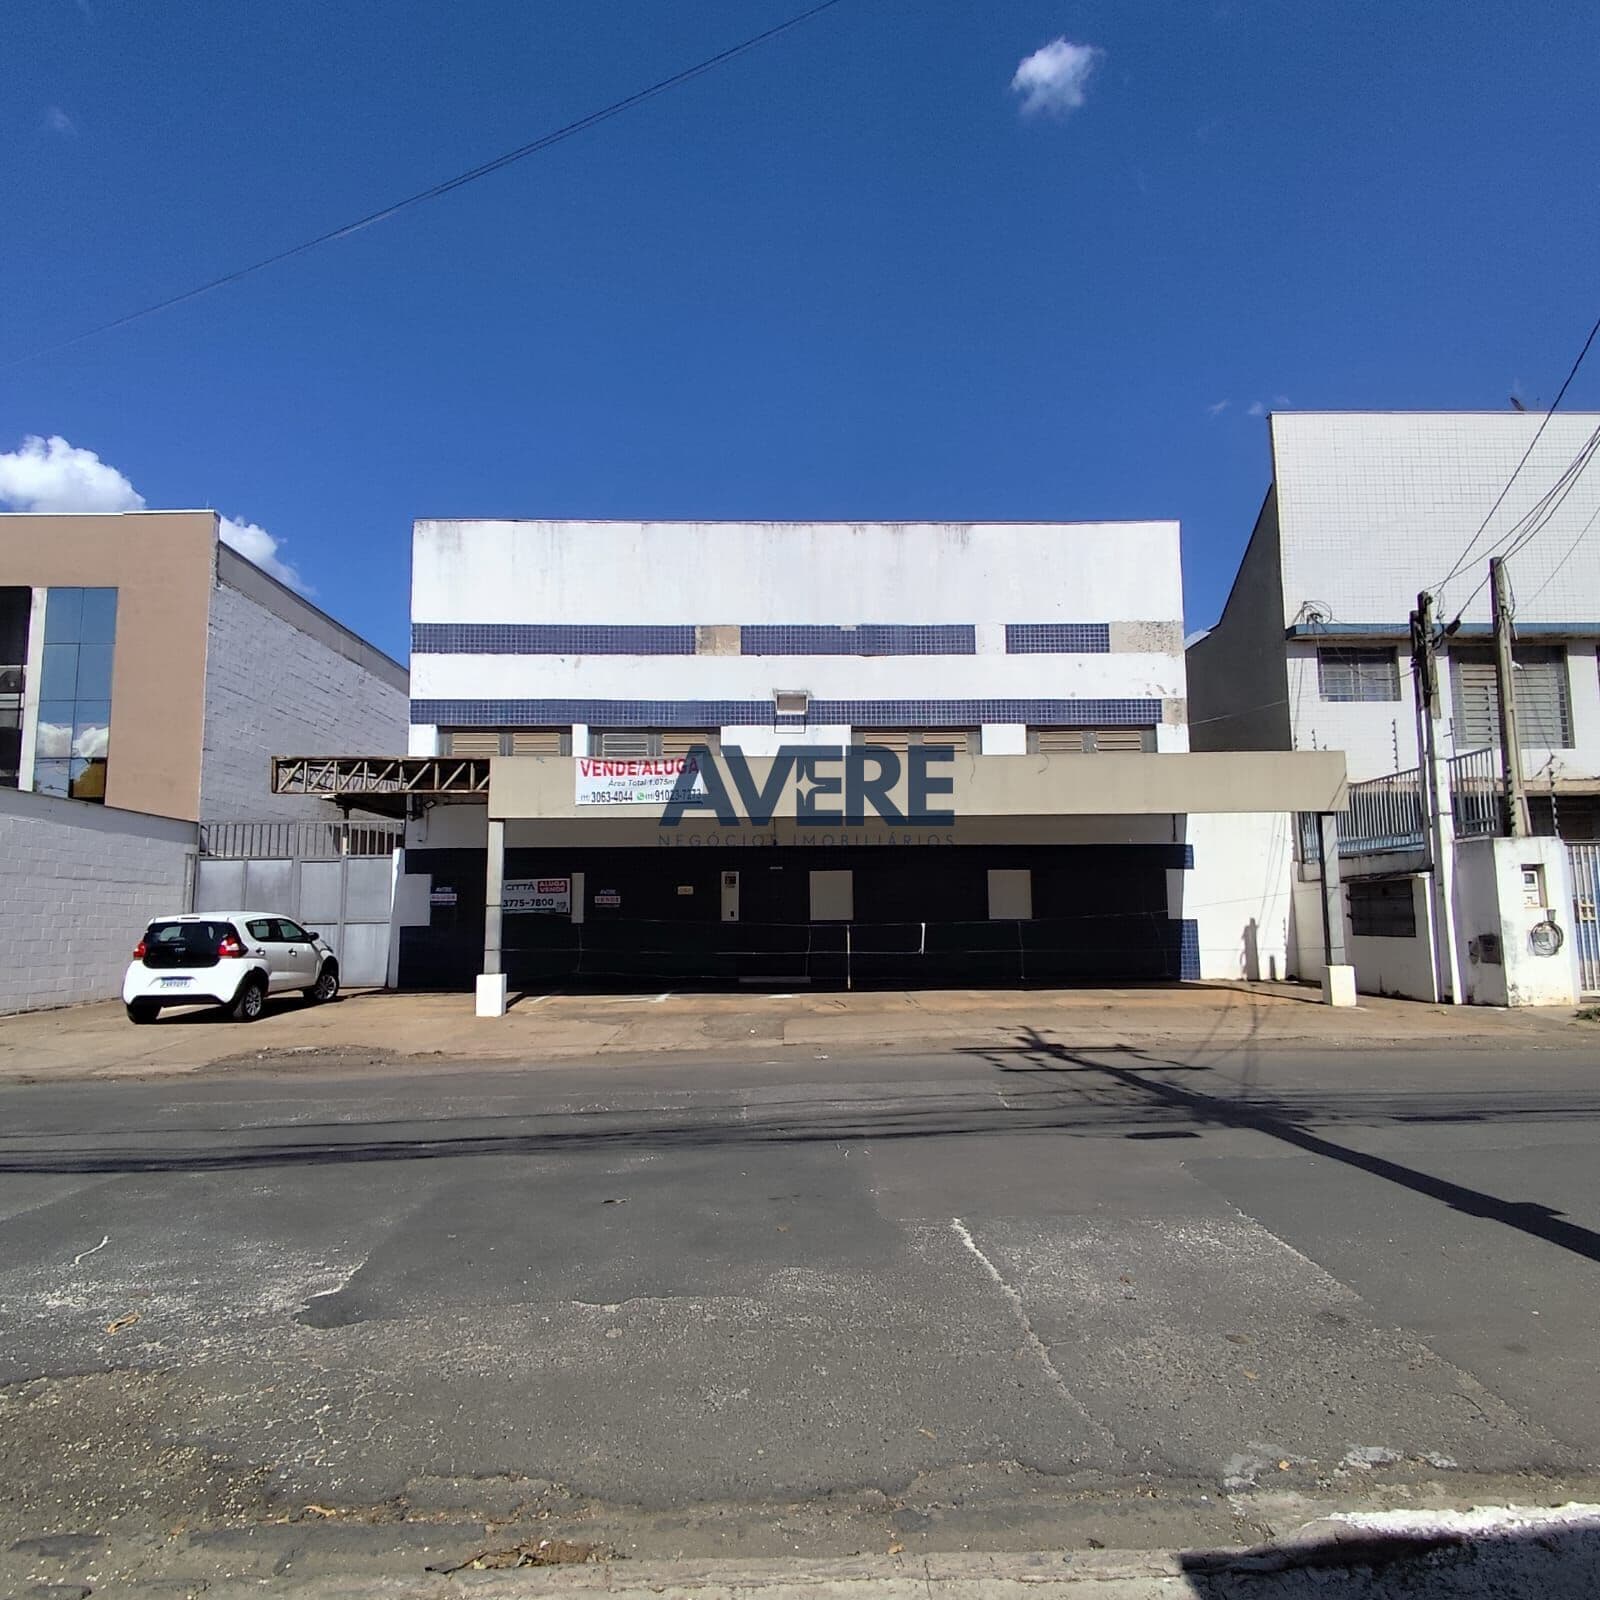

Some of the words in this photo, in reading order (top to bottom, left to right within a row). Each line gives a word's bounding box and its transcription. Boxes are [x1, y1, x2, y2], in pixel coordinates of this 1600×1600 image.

[629, 778, 646, 786] Total
[591, 791, 633, 803] 3063-4044
[503, 898, 553, 908] 3775-7800
